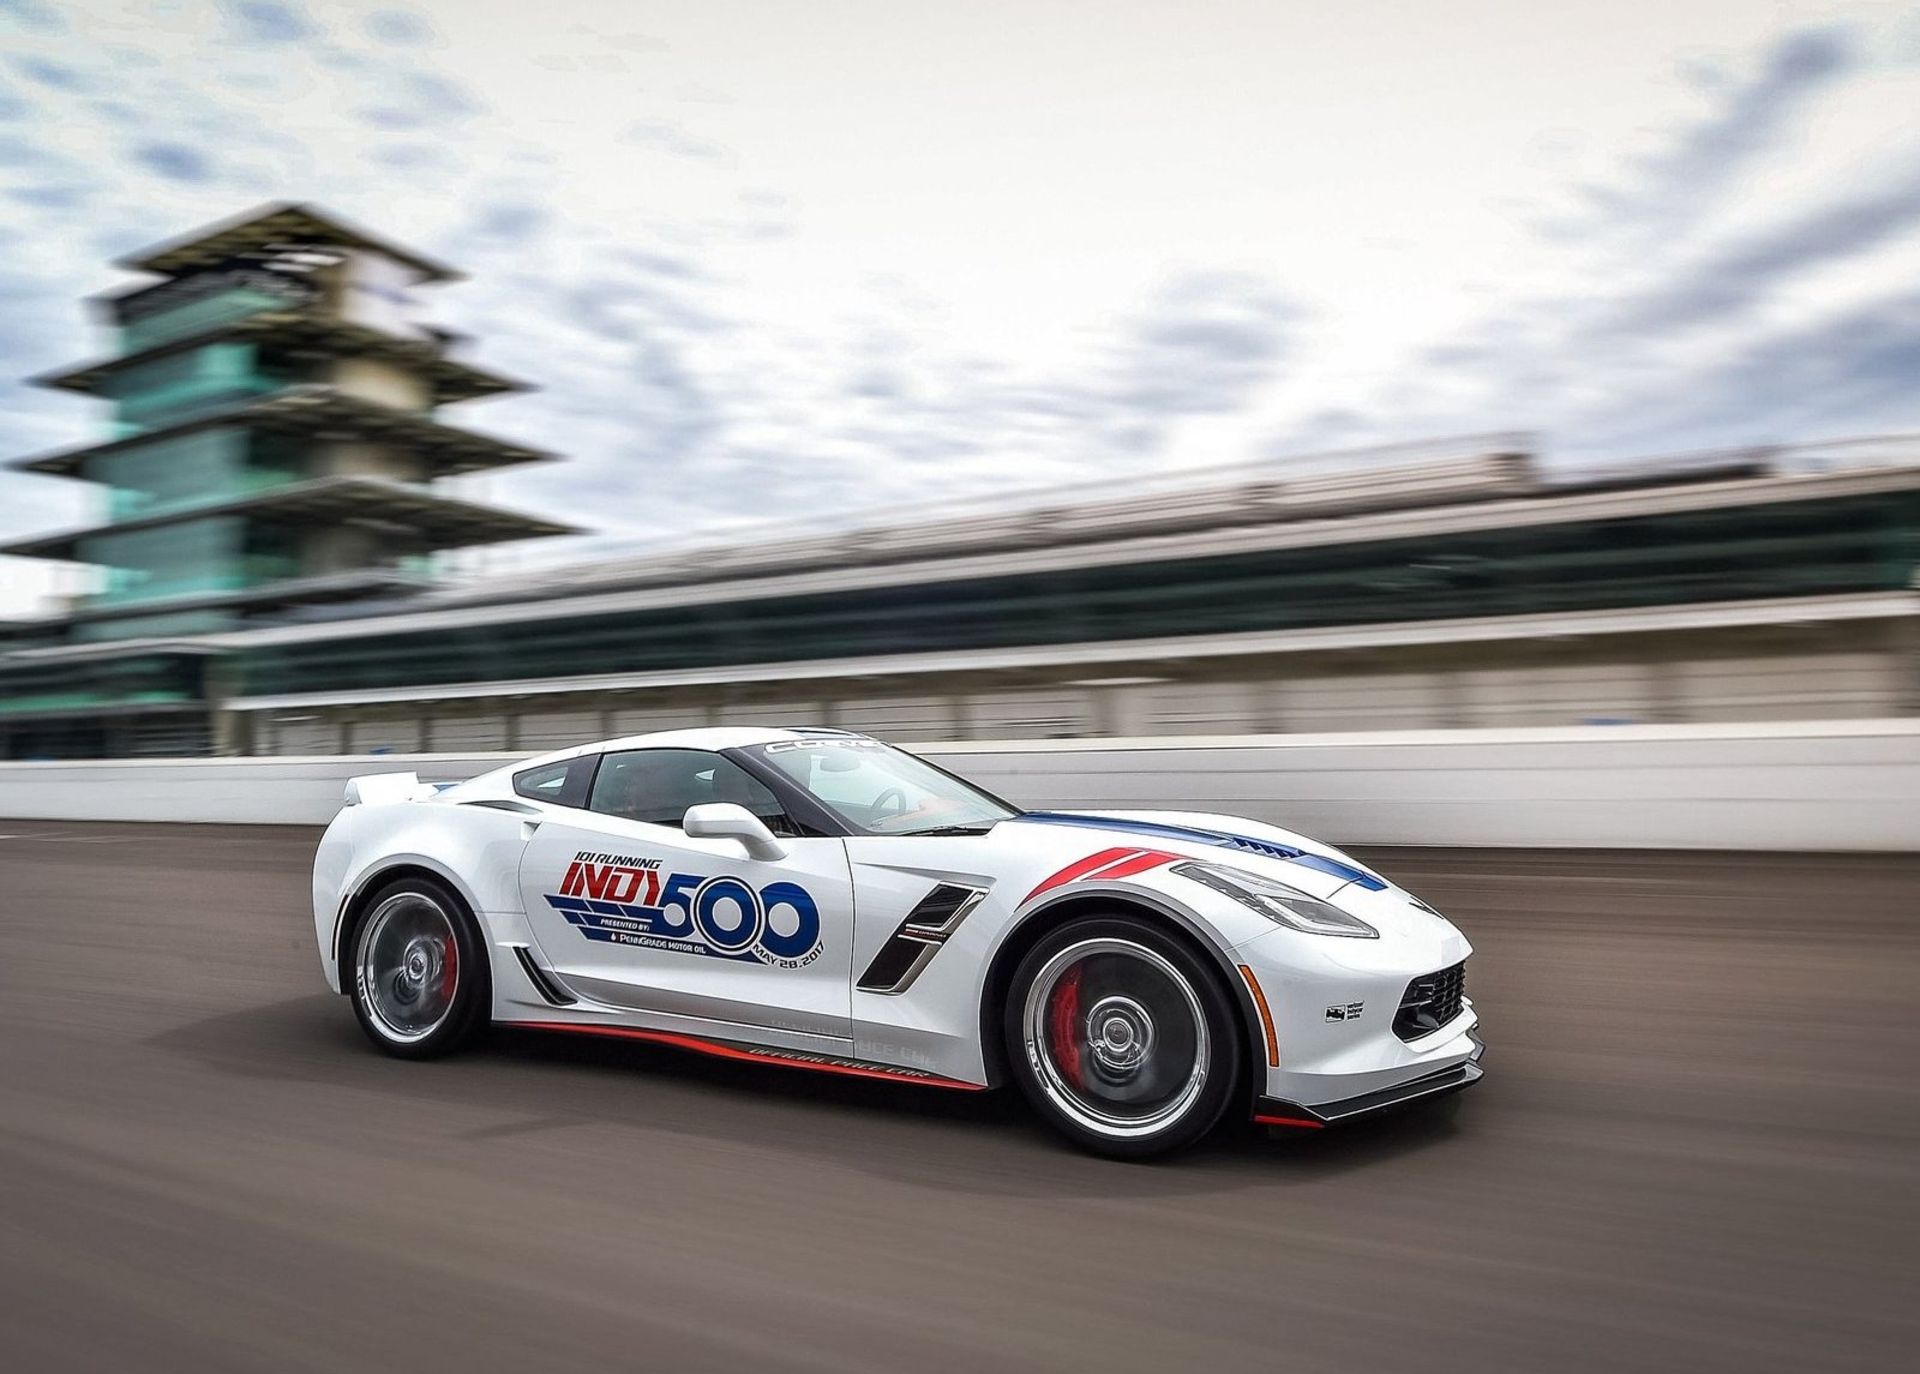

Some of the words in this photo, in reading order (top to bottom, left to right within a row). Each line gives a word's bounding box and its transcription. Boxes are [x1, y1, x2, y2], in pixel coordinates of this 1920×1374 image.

[558, 862, 661, 907] INDY
[657, 872, 821, 958] 500
[600, 918, 637, 930] PRESENTED
[668, 942, 693, 952] MOTOR
[694, 946, 706, 954] OIL
[752, 944, 778, 965] MAY
